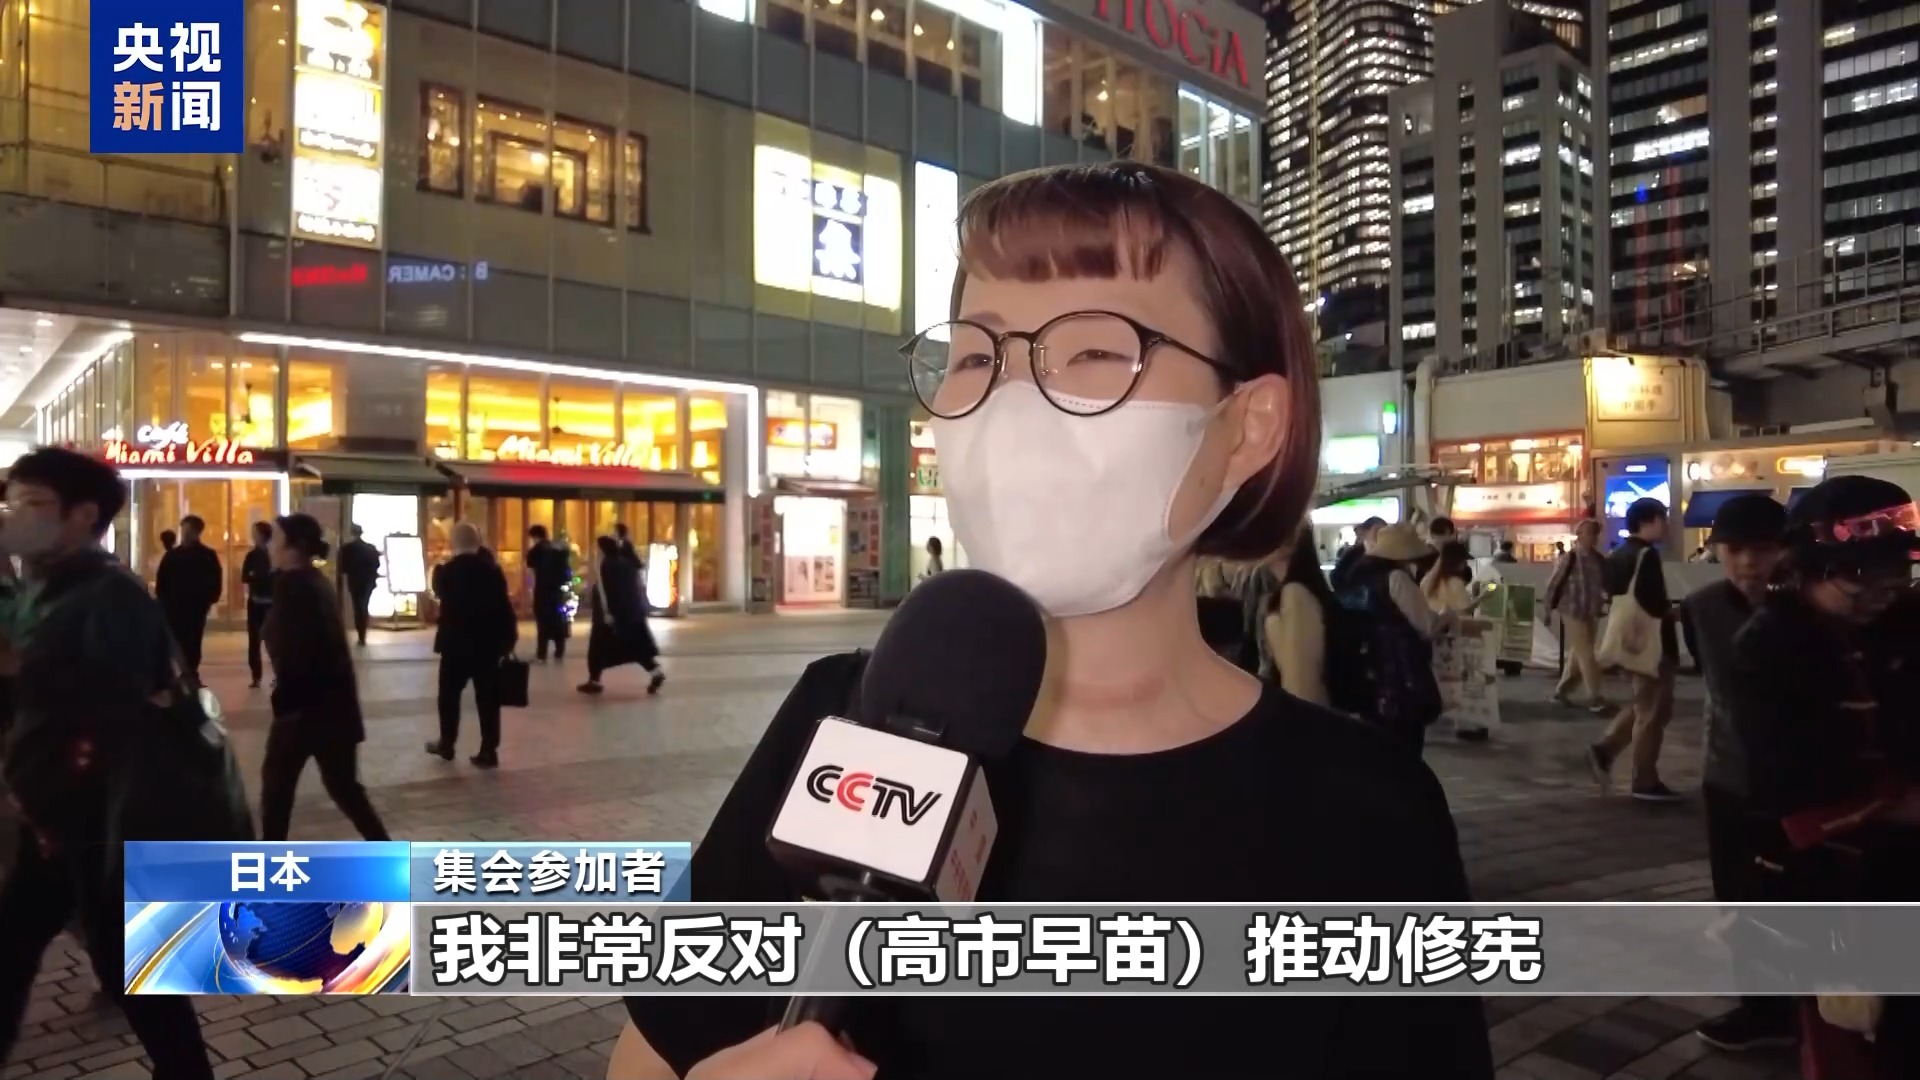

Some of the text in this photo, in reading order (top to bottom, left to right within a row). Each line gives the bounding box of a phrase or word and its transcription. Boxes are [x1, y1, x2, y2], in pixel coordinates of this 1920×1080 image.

[1096, 0, 1248, 88] OCiA
[105, 436, 253, 464] Miami Villa
[806, 764, 943, 826] CCTV
